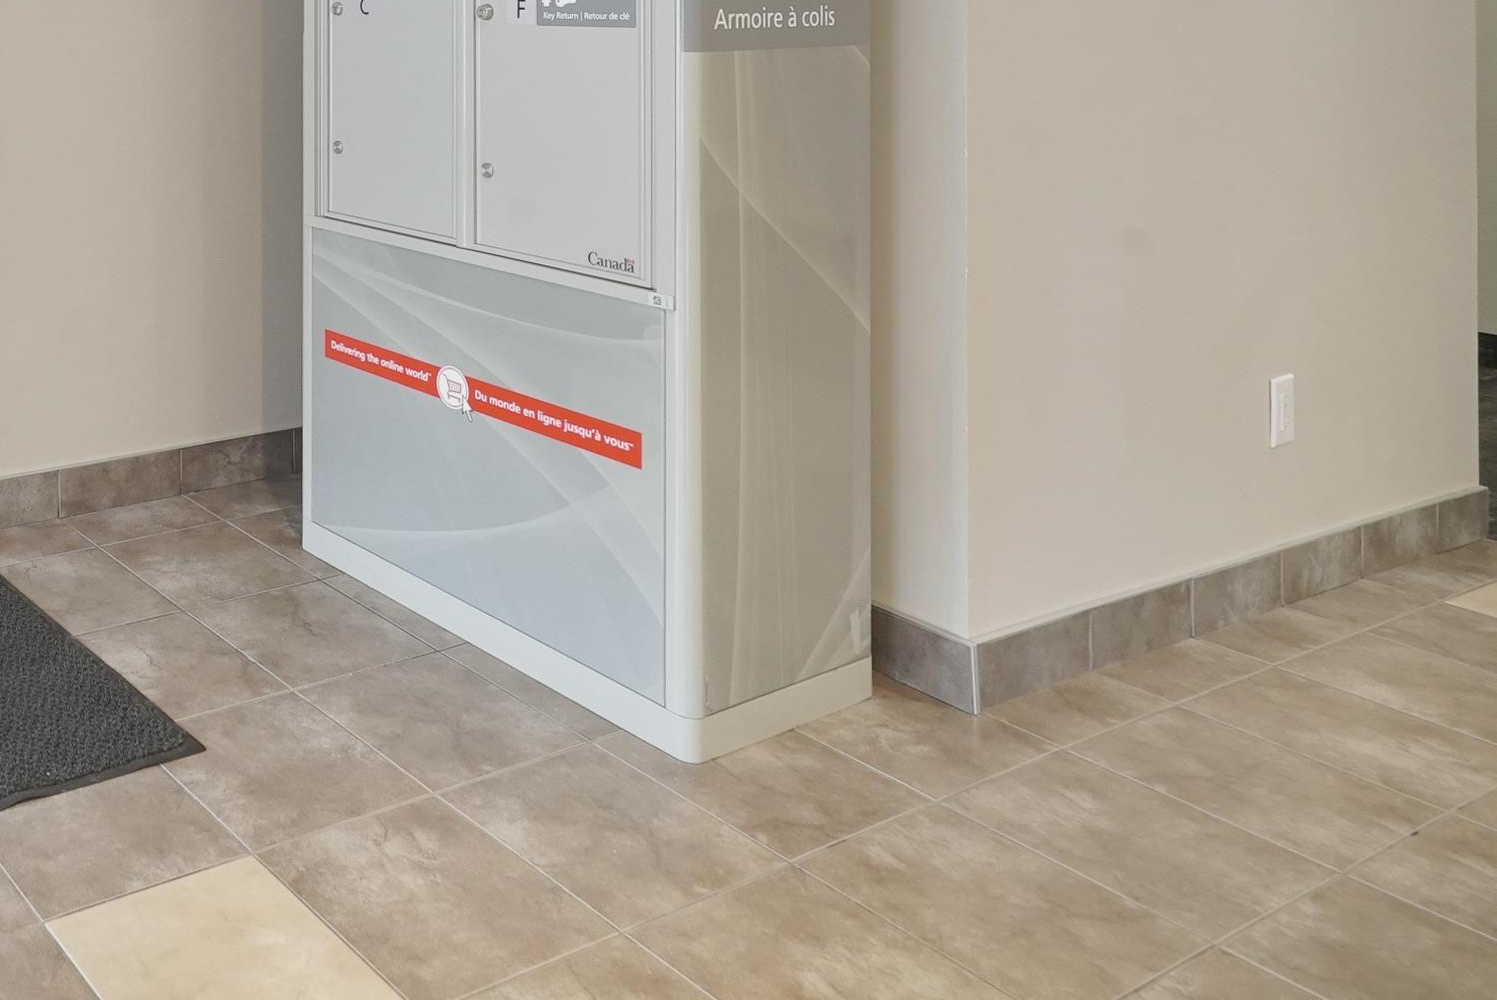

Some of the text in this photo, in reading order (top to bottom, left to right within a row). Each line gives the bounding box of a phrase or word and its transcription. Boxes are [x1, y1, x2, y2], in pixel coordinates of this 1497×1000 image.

[518, 0, 526, 19] F
[543, 11, 631, 21] Key Return Retour de clé
[713, 5, 836, 30] Armoire à colis
[587, 251, 635, 274] Canada
[331, 340, 365, 362] Delivering
[367, 353, 380, 365] the
[380, 359, 404, 373] online
[474, 389, 488, 403] Du
[489, 396, 522, 414] monde
[523, 406, 536, 419] en
[537, 410, 562, 426] ligne
